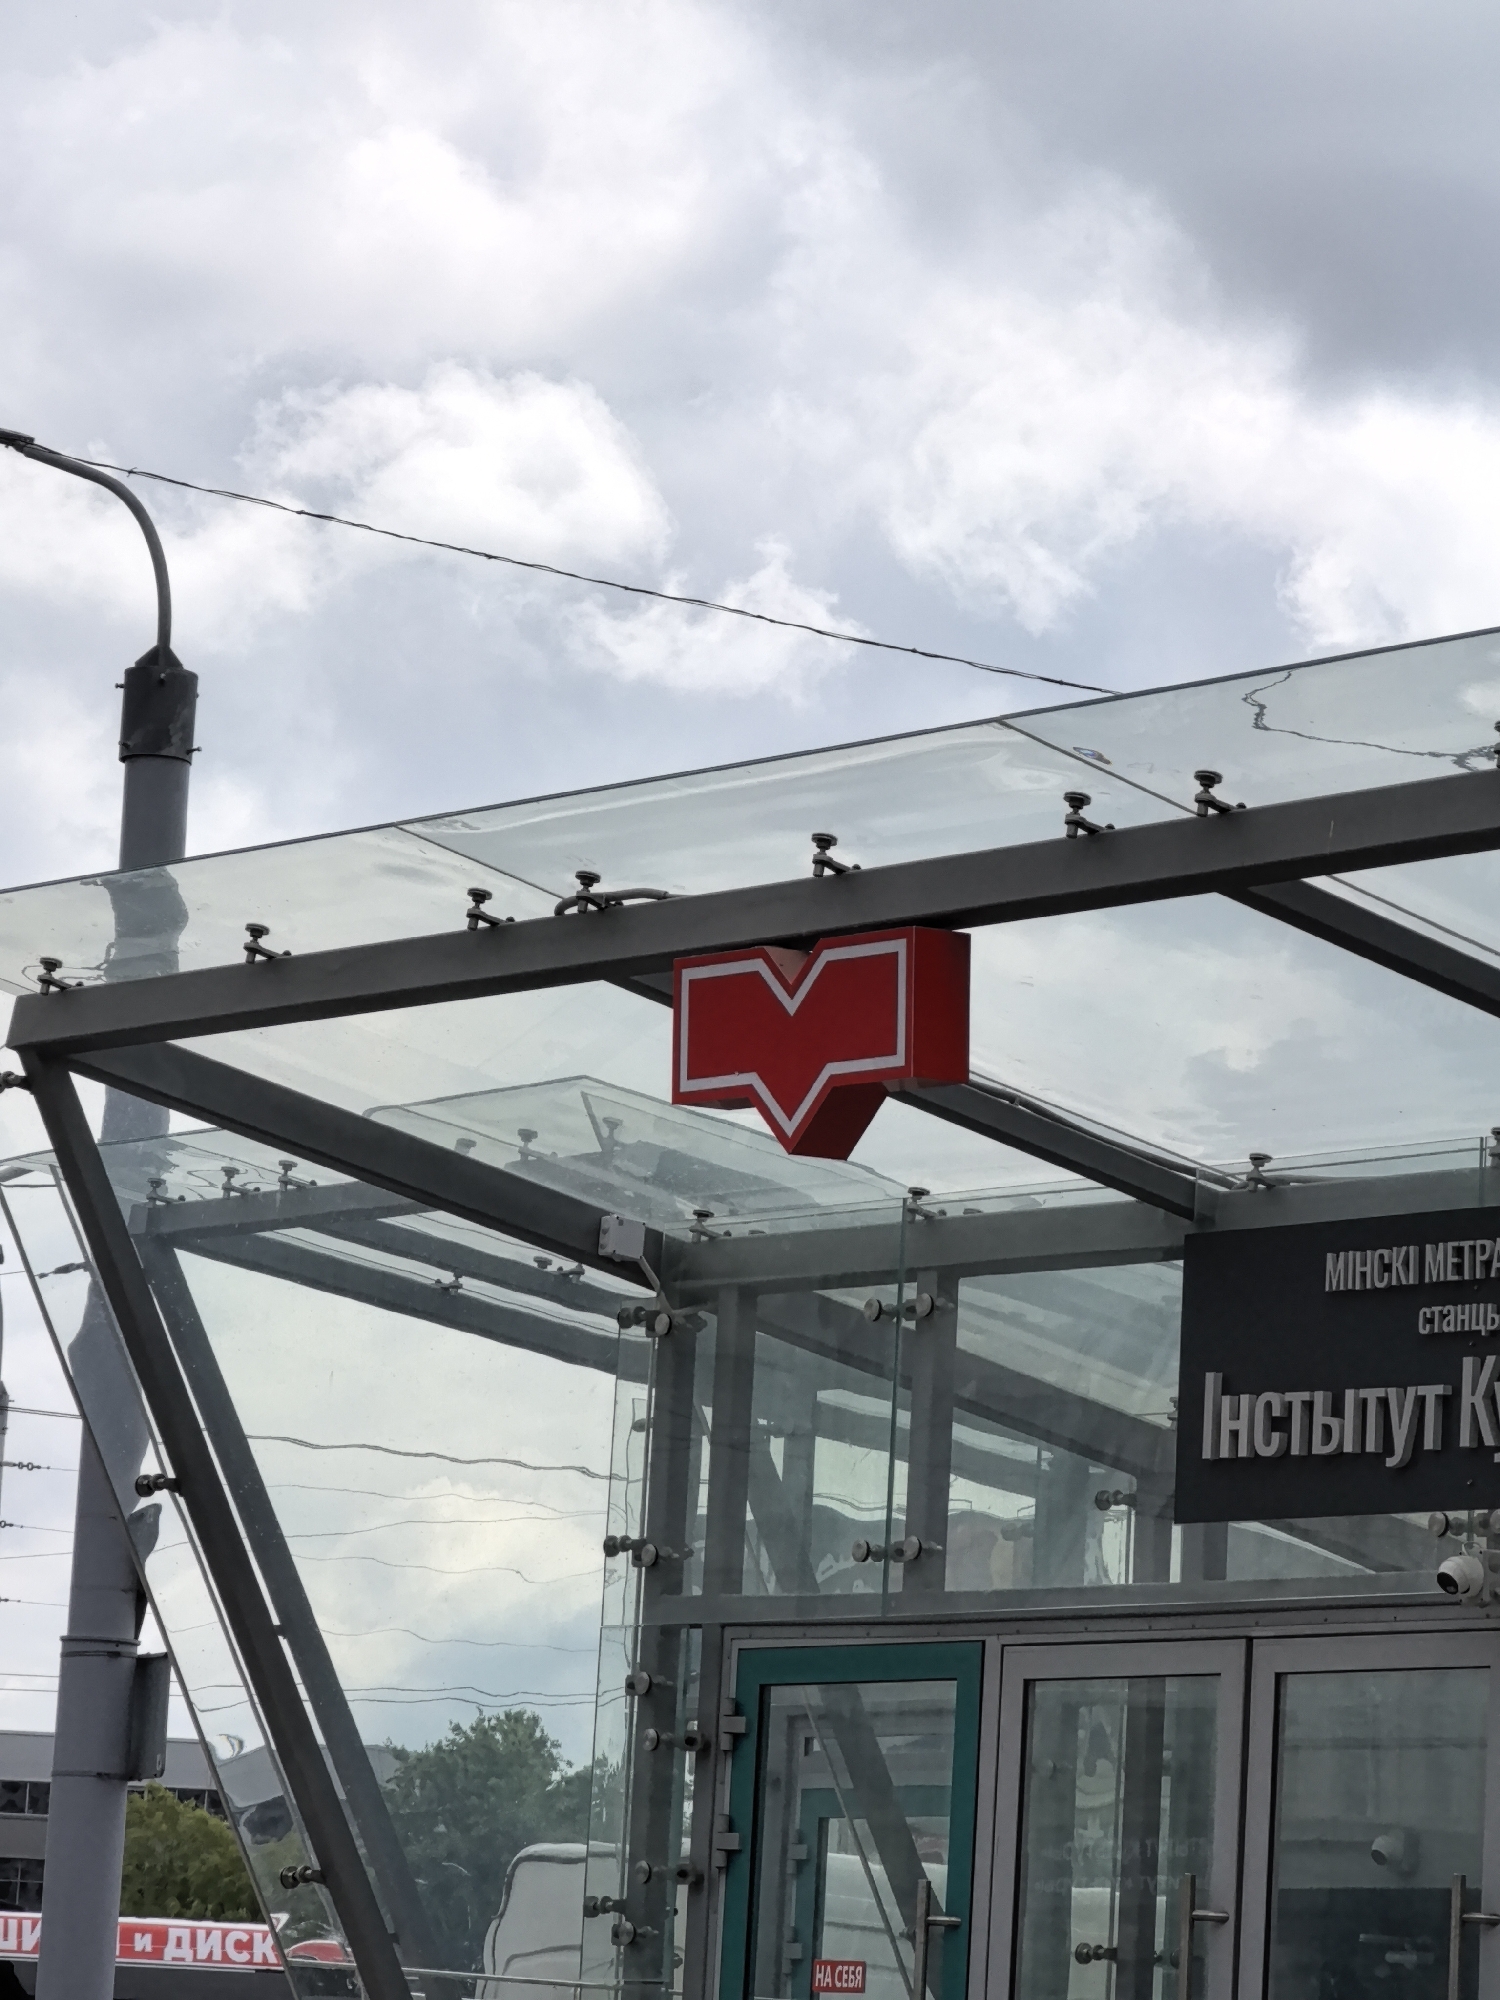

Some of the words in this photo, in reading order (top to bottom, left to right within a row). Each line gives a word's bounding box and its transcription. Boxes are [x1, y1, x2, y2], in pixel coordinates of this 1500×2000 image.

[1324, 1245, 1419, 1292] МІНСКІ
[1202, 1371, 1452, 1468] Інстытут
[1459, 1355, 1500, 1463] К
[815, 1964, 832, 1988] НА
[834, 1965, 863, 1988] СЕБЯ
